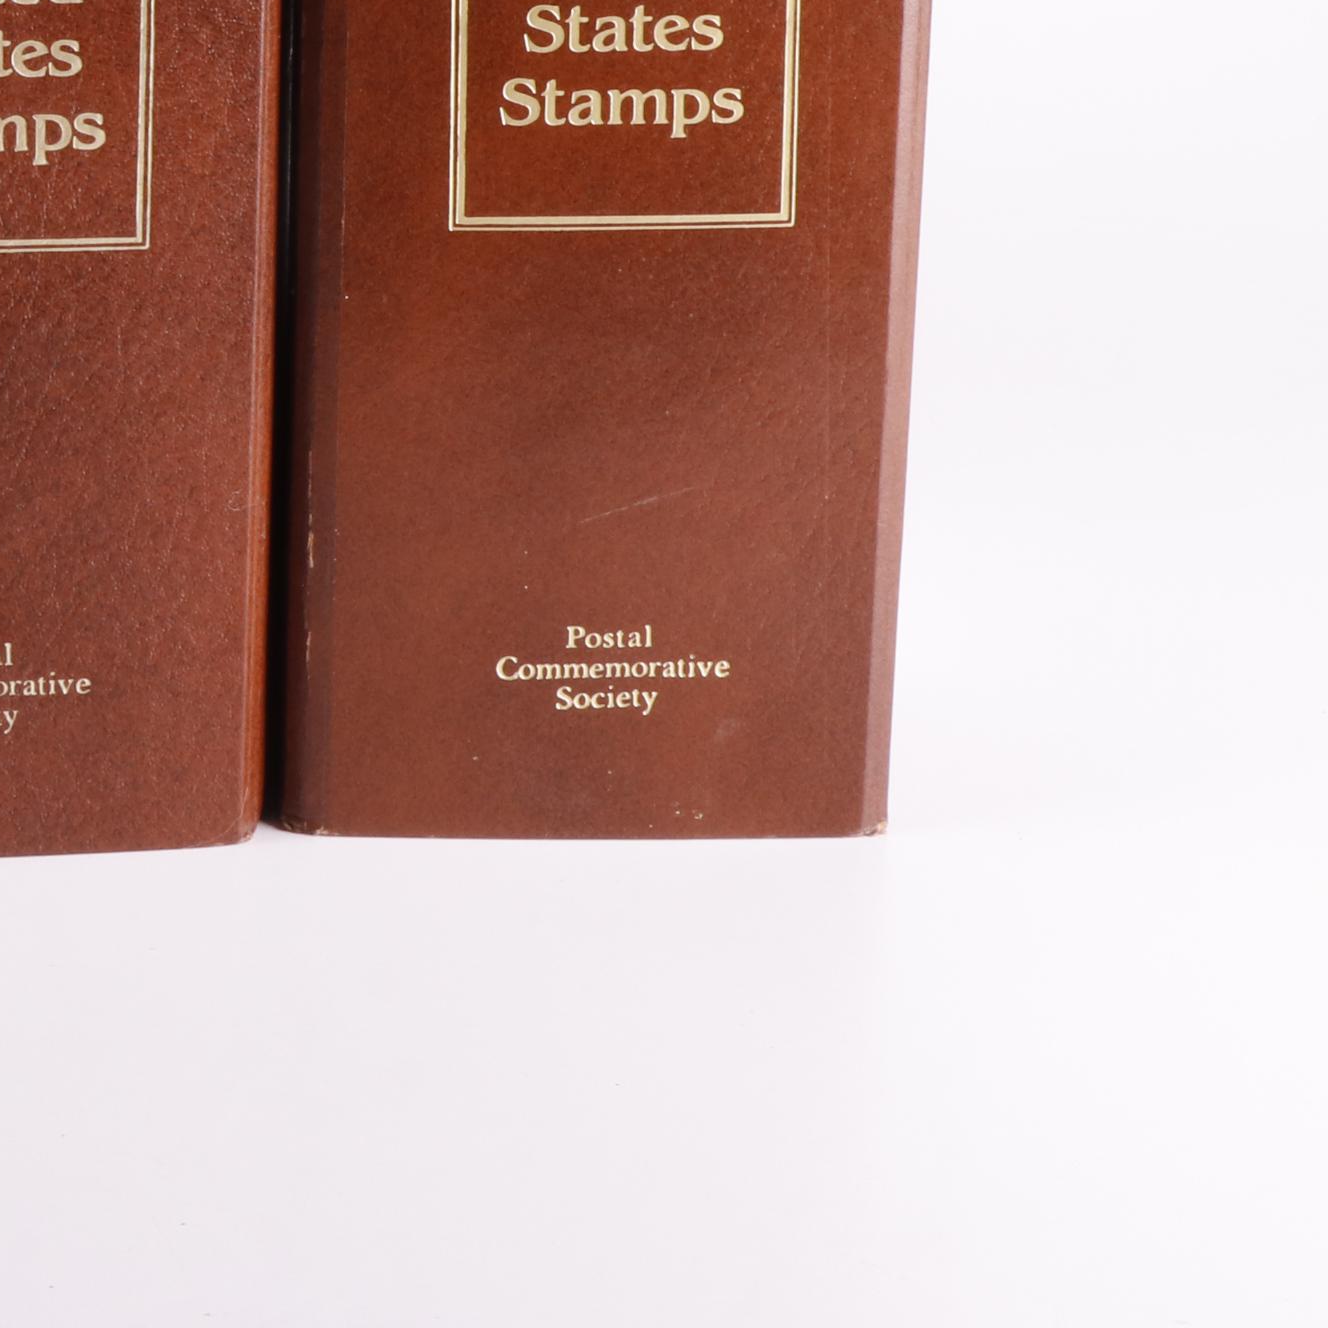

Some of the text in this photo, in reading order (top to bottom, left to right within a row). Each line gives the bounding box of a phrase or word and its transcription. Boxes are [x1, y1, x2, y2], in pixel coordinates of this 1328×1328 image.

[524, 4, 724, 53] States
[499, 77, 745, 138] Stamps
[566, 625, 652, 648] Postal
[496, 654, 731, 680] Commemorative
[555, 685, 658, 715] Society
